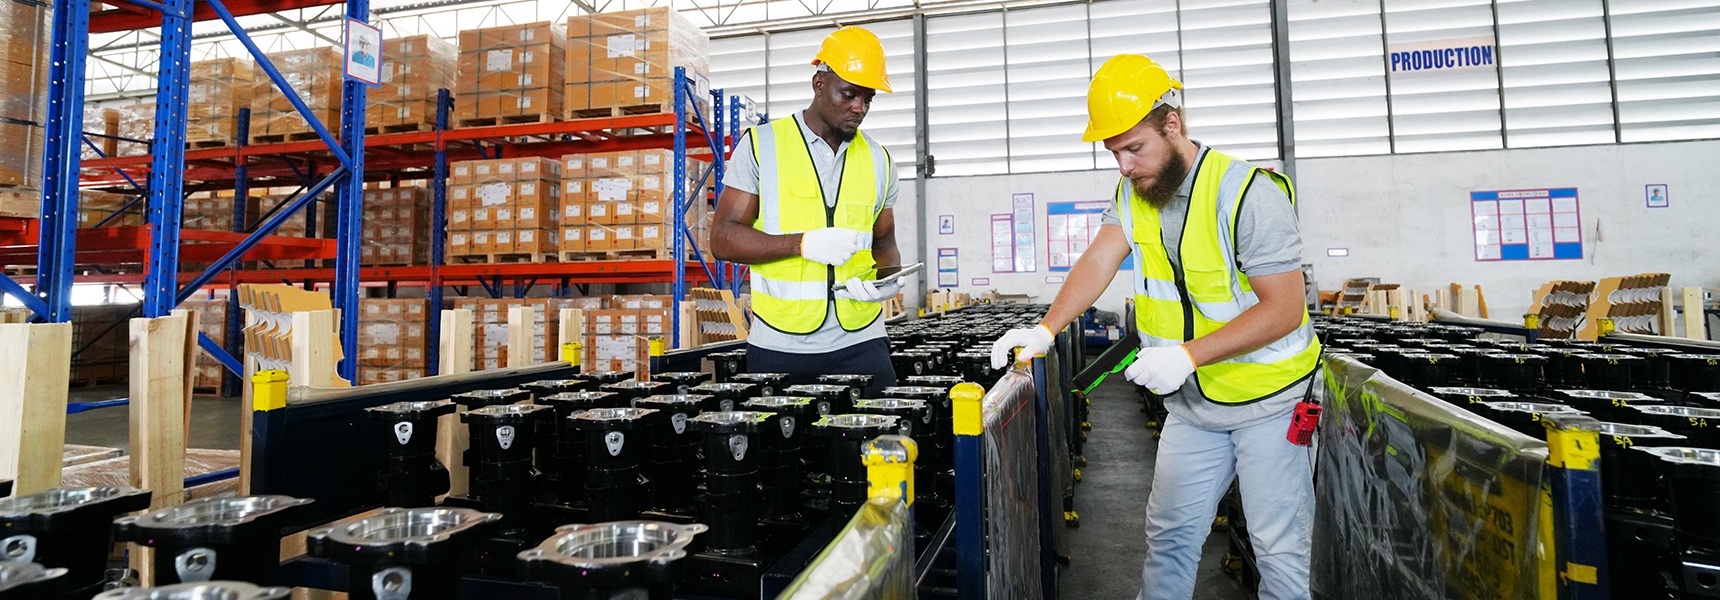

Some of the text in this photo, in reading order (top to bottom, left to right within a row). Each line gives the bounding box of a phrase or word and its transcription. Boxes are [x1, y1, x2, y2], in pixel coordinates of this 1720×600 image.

[1391, 45, 1493, 71] PRODUCTION
[698, 78, 706, 97] C
[1611, 399, 1627, 408] 5A
[1688, 417, 1707, 428] 5A
[1613, 434, 1634, 449] 5A
